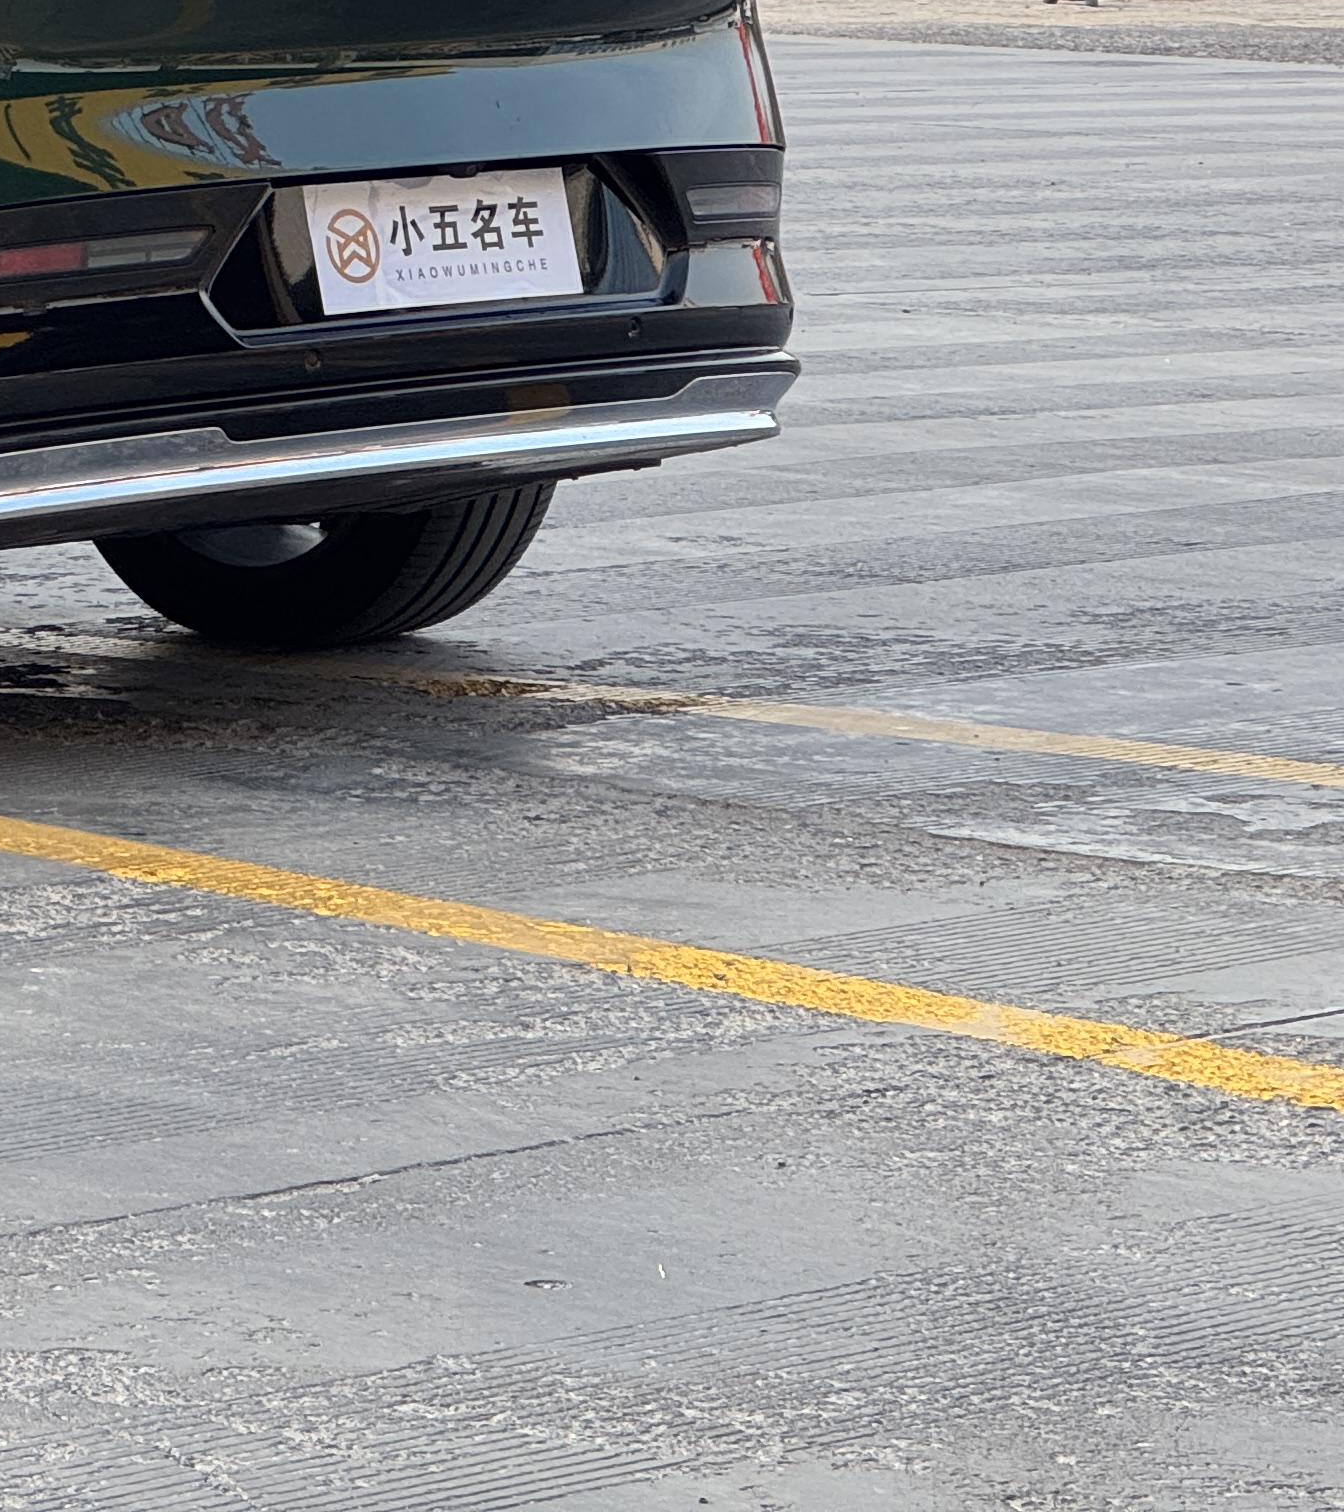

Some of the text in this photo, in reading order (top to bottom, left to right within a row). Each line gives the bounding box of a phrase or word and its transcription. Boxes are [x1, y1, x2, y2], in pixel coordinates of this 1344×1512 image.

[389, 196, 545, 257] 小五名车
[395, 257, 549, 282] XIAOWUMINGCHE
